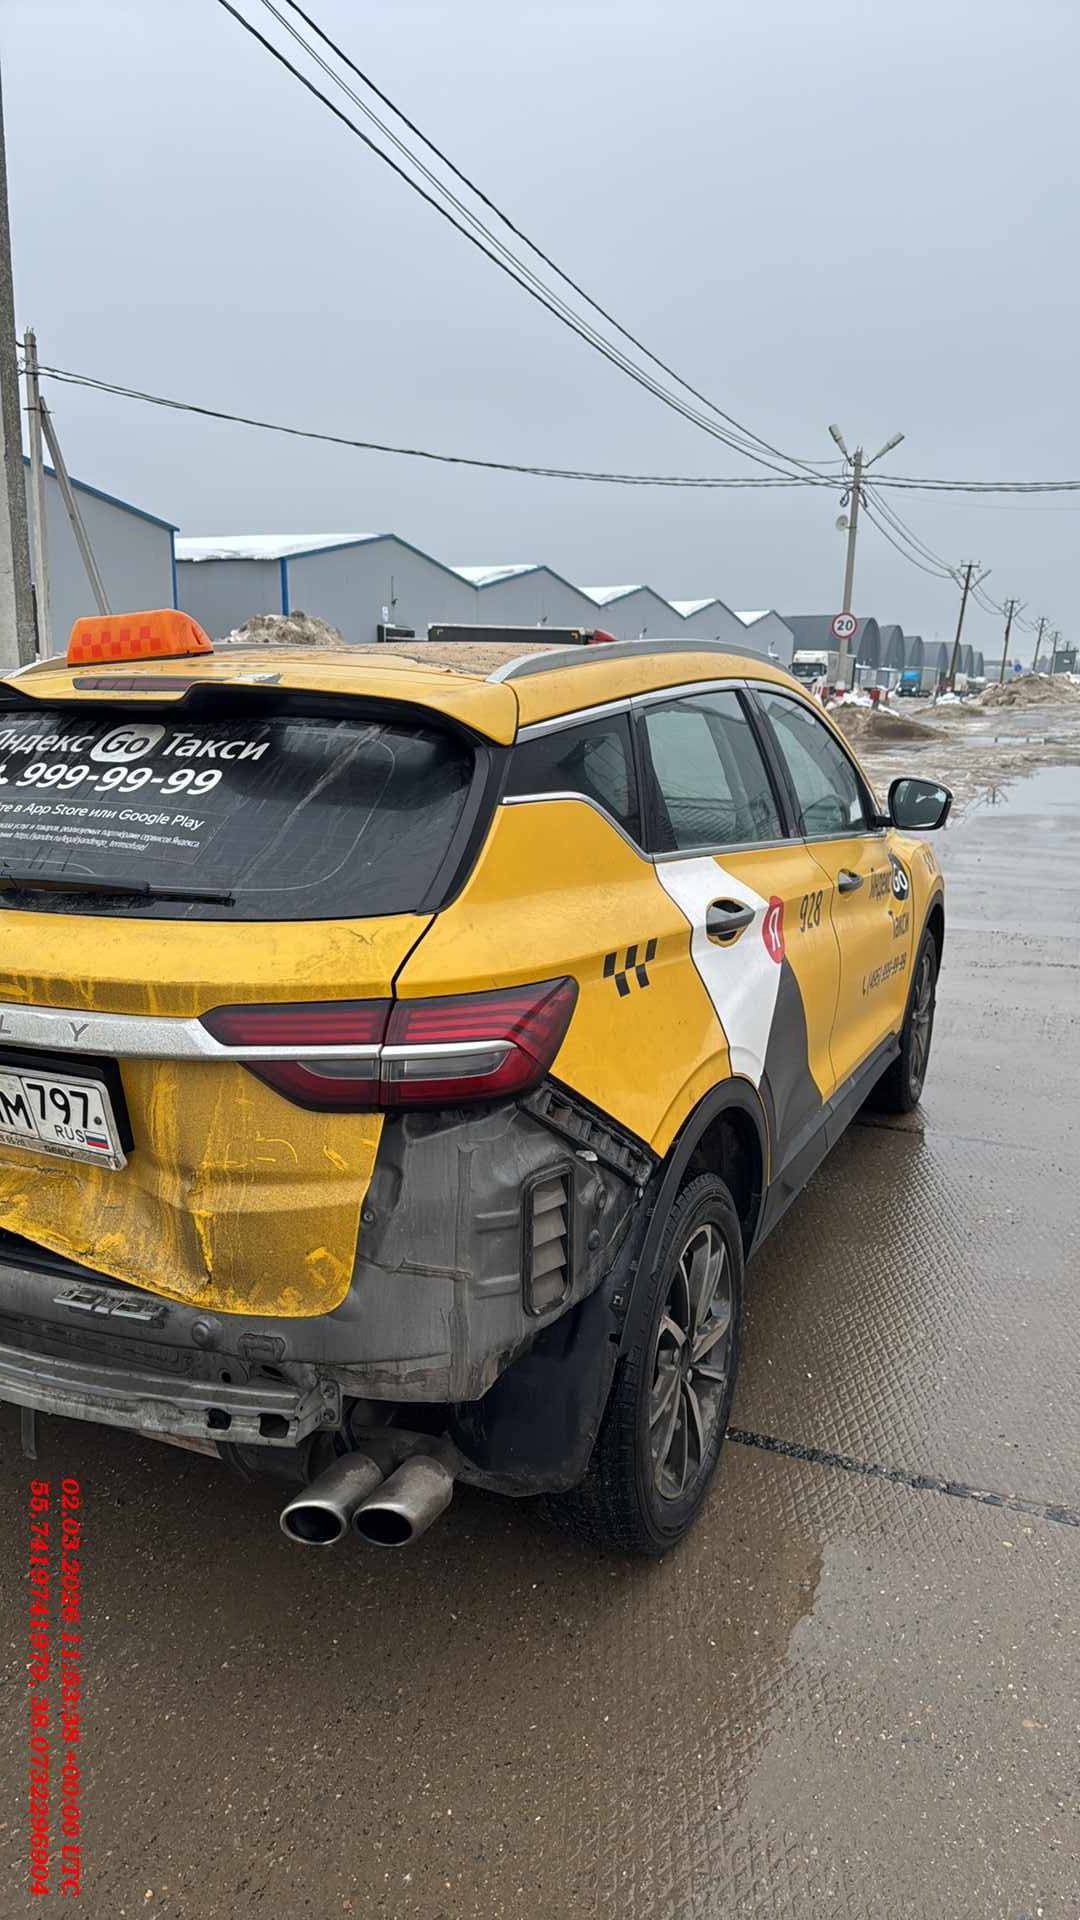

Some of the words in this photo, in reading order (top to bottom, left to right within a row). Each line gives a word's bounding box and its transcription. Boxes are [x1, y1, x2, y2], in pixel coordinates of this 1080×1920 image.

[836, 620, 853, 631] 20
[100, 731, 151, 753] Go
[162, 733, 270, 760] Такси
[16, 762, 223, 795] 999-99-99
[13, 804, 23, 813] в
[21, 803, 52, 816] App
[51, 803, 89, 817] Store
[88, 808, 117, 819] или
[118, 809, 170, 826] Google
[171, 815, 205, 831] Play
[799, 889, 823, 933] 928
[26, 1083, 89, 1129] 797
[54, 1124, 85, 1143] RUS
